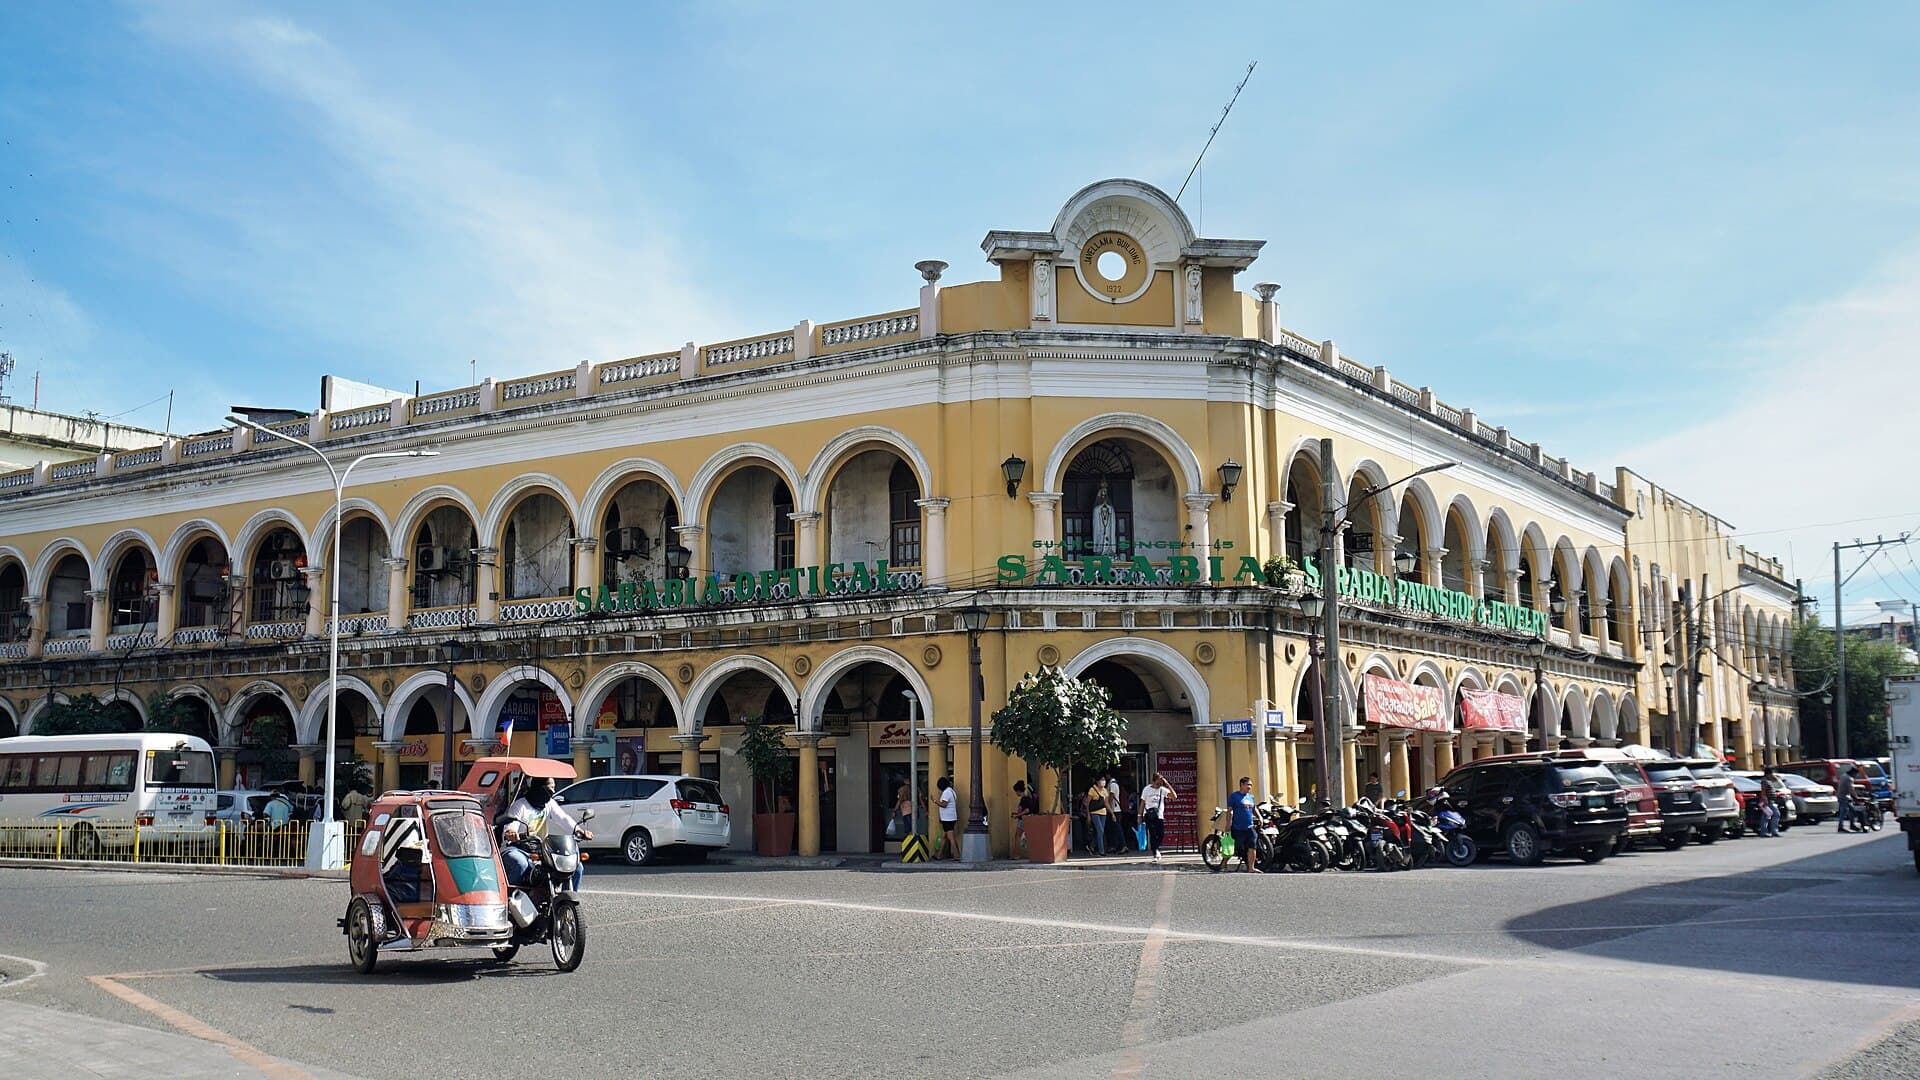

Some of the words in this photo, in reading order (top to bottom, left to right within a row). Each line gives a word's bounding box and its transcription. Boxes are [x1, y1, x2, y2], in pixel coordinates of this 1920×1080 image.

[1083, 236, 1114, 265] JAVELLANA
[1116, 237, 1142, 265] BUILDING
[997, 555, 1267, 582] SARABIA
[575, 574, 721, 613] SARABIA
[735, 559, 900, 600] OPTICAL
[1303, 555, 1394, 604] SRABIA
[1395, 578, 1476, 623] PAWNSHOP
[1485, 600, 1549, 636] JEWELRY
[1413, 693, 1438, 721] Sale
